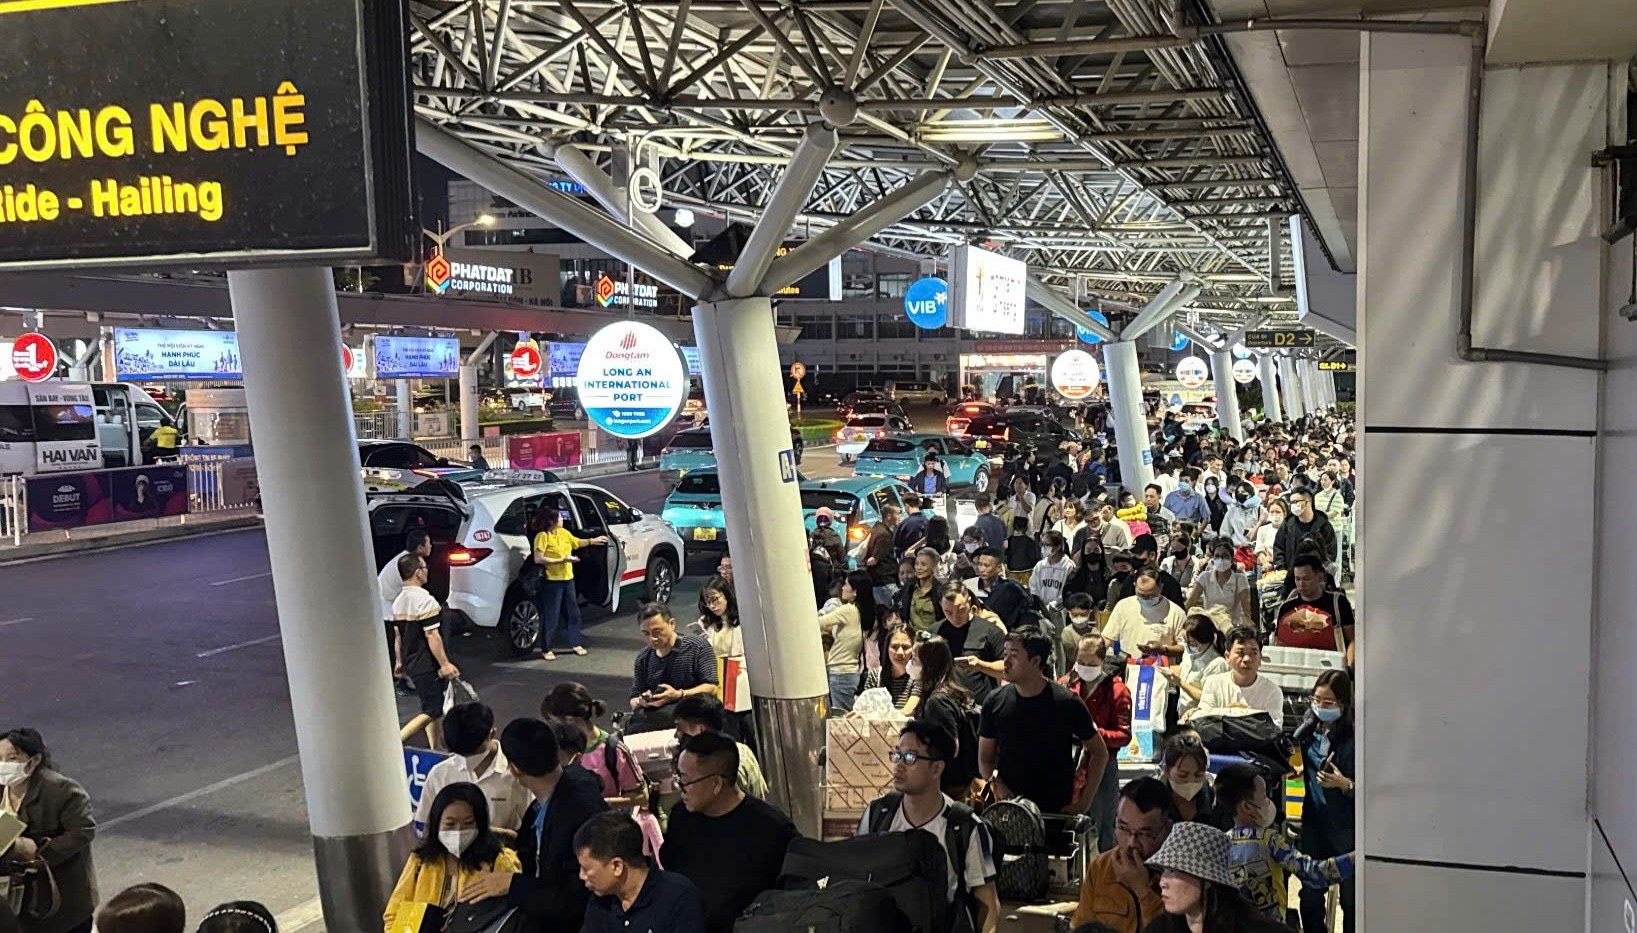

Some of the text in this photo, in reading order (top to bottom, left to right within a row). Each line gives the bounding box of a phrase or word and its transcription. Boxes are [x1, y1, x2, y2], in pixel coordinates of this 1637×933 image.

[0, 80, 309, 165] CÔNG NGHỆ
[90, 176, 224, 221] Hailing
[451, 262, 513, 284] PHATDAT
[451, 279, 513, 294] CORPORATION
[907, 300, 937, 315] VIB
[1274, 332, 1295, 346] D2
[602, 368, 652, 377] LONG AN
[584, 380, 672, 389] INTERNATIONAL
[613, 393, 643, 402] PORT
[68, 449, 98, 461] VAN
